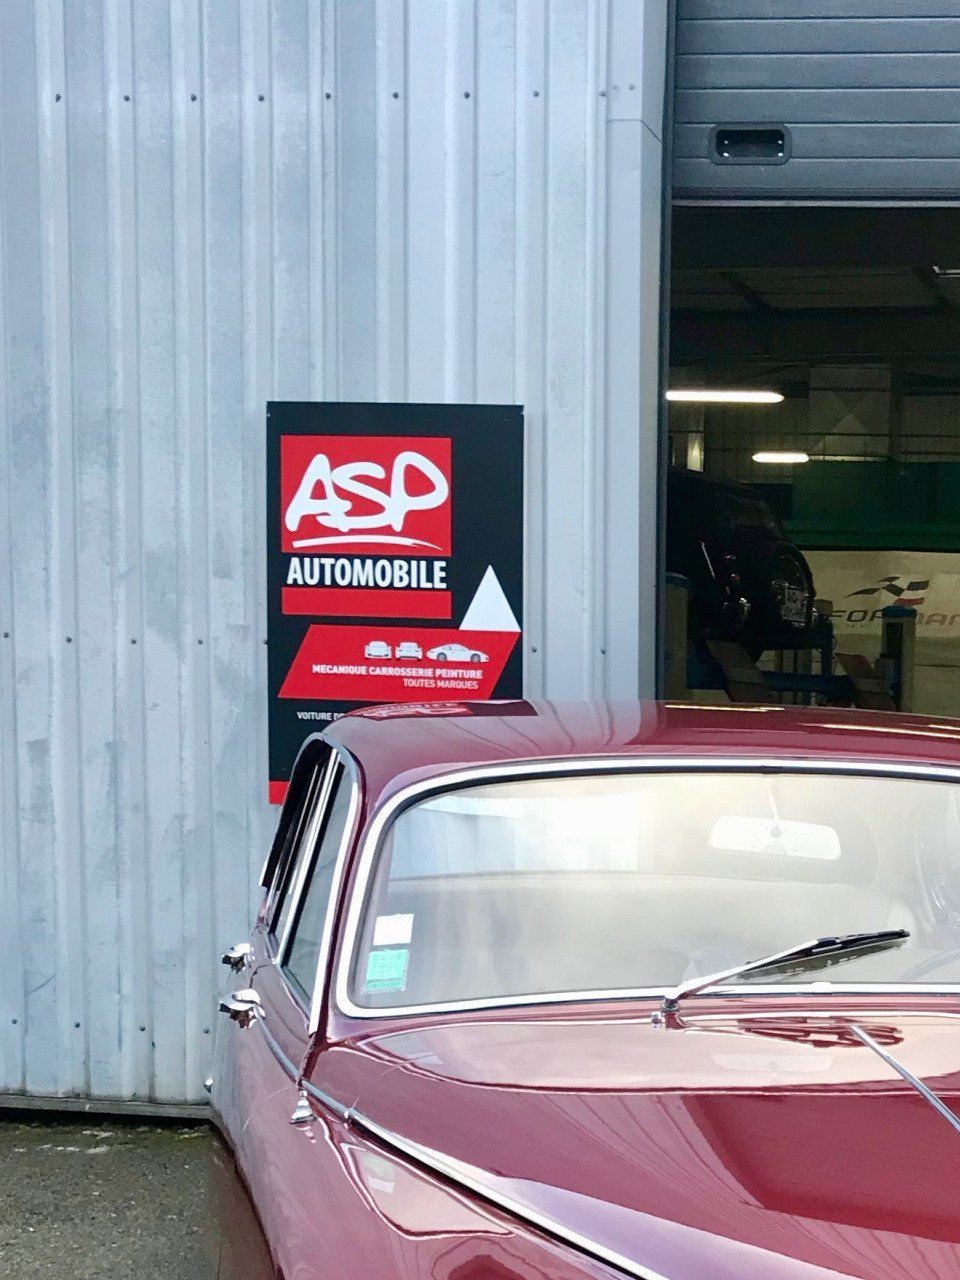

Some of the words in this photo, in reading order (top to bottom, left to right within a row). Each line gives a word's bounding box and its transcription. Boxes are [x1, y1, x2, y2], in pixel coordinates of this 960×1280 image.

[285, 451, 450, 532] ASP
[286, 556, 447, 590] AUTOMOBILE
[312, 664, 367, 676] MECANIQUE
[368, 667, 434, 678] CARROSSERIE
[435, 668, 483, 680] PEINTURE
[403, 678, 435, 689] TOUTES
[437, 680, 479, 691] MARQUES
[296, 711, 333, 721] VOITURE
